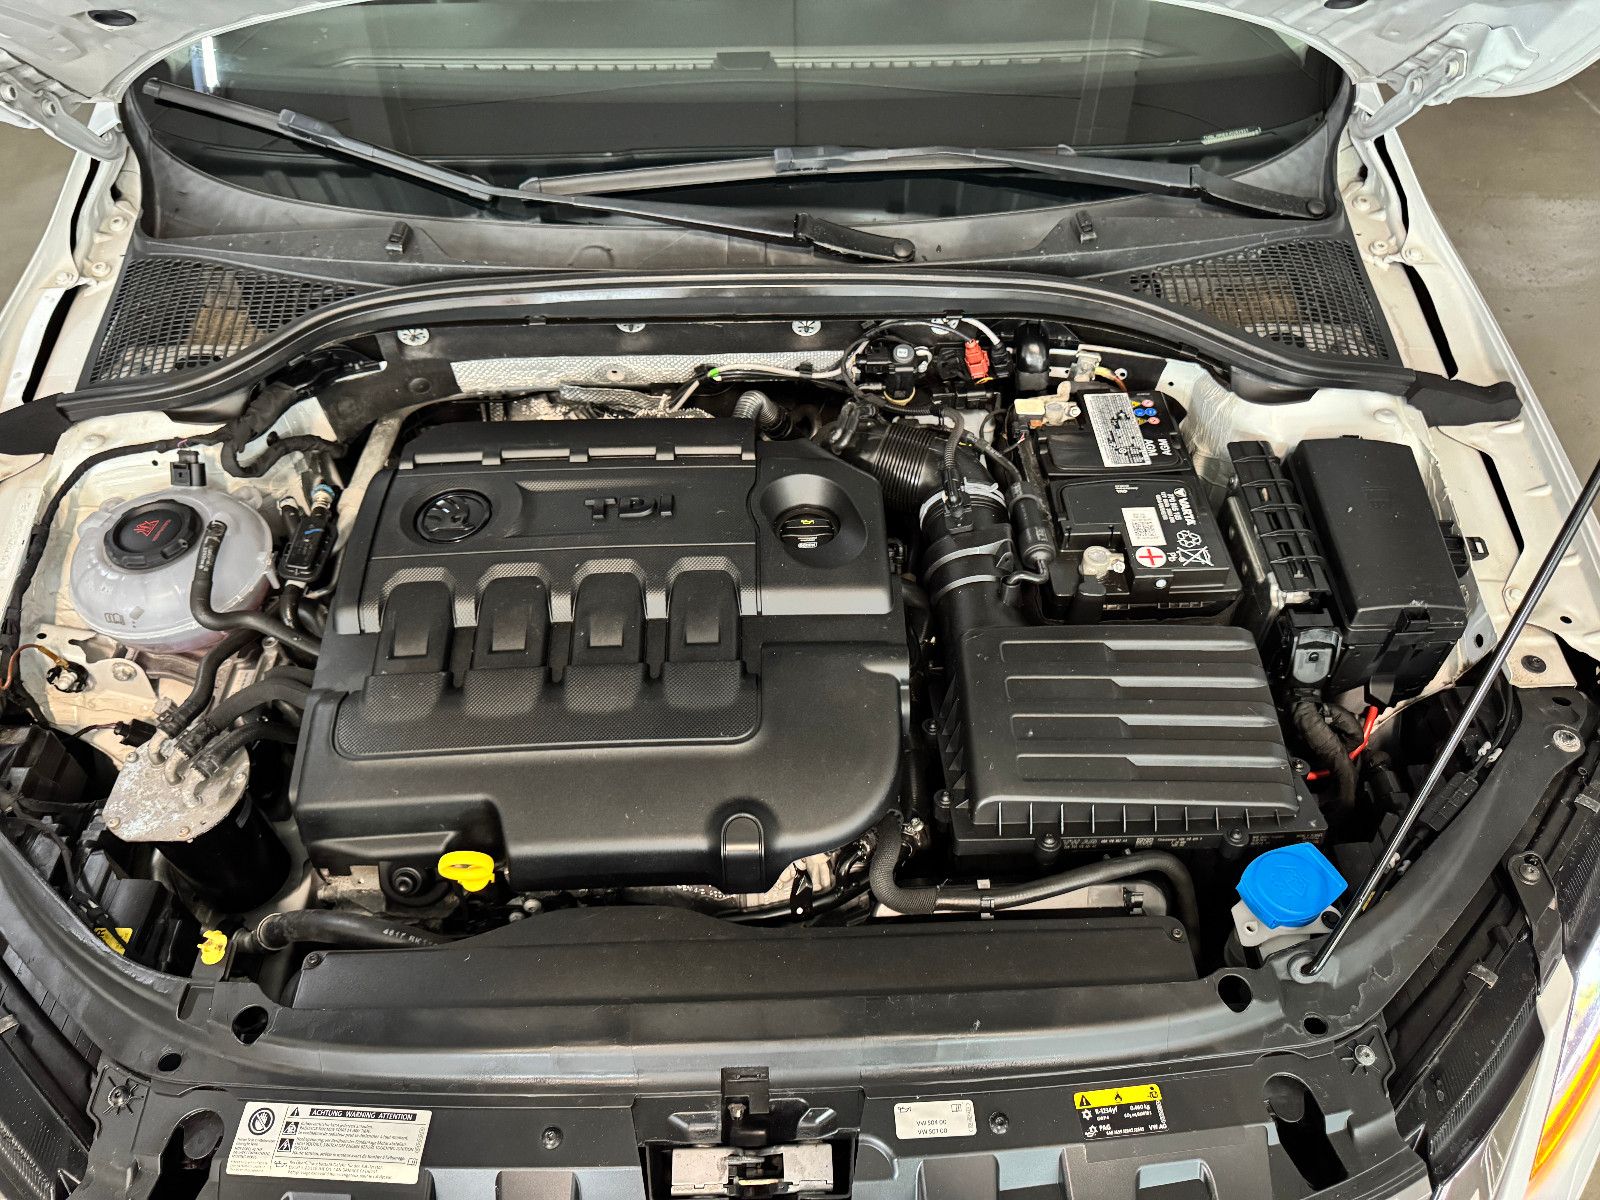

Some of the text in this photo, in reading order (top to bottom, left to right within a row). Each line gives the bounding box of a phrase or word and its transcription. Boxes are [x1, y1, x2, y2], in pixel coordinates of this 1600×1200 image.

[1158, 438, 1172, 455] AGM
[584, 495, 674, 519] TDI
[1178, 497, 1196, 526] VARTA
[1167, 552, 1179, 562] Pb
[311, 1109, 413, 1120] ACHTUNG WARNING ATTENTION
